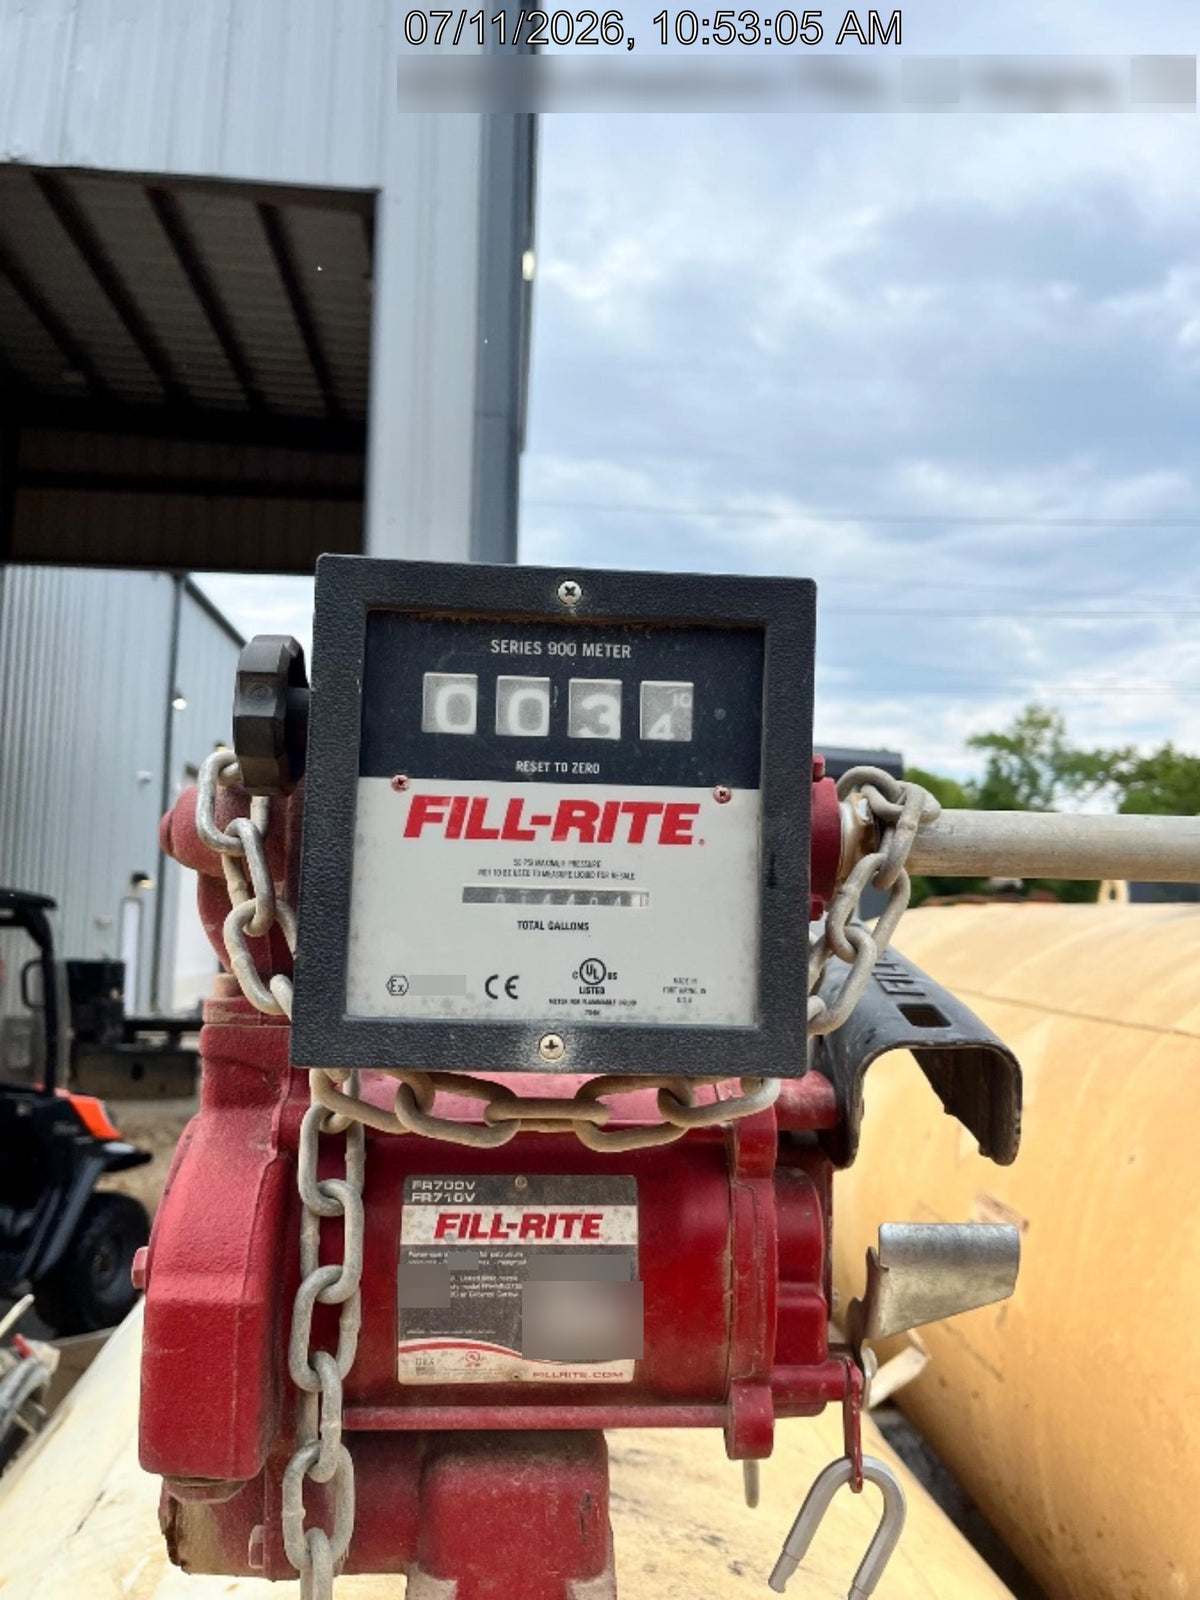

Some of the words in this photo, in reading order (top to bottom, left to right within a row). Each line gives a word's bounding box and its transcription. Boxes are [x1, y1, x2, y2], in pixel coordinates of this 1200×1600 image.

[490, 639, 543, 656] SERIES
[547, 641, 577, 657] 900
[582, 643, 632, 659] METER
[516, 760, 551, 773] RESET
[554, 761, 569, 773] TO
[572, 762, 601, 775] ZERO
[403, 794, 702, 846] FILL-RITE
[516, 920, 545, 931] TOTAL
[547, 920, 590, 932] GALLONS
[485, 973, 520, 1000] CE
[579, 986, 605, 995] LISTED
[411, 1192, 476, 1203] FR710V
[433, 1212, 604, 1240] FILL-RITE
[532, 1371, 625, 1379] FILLRITE.COM
